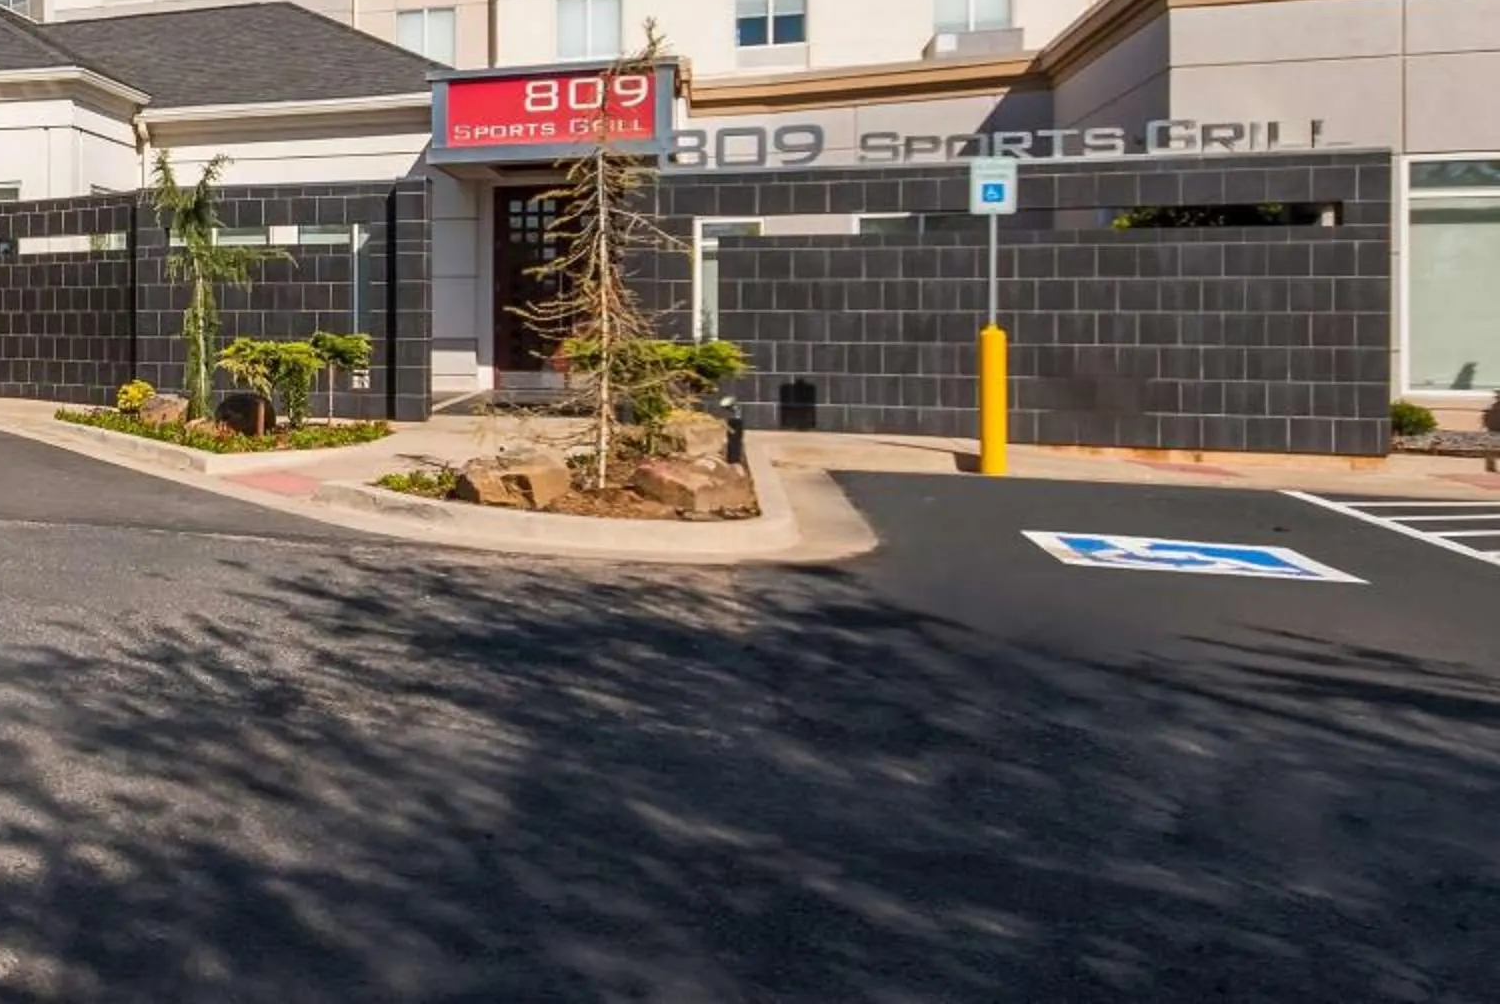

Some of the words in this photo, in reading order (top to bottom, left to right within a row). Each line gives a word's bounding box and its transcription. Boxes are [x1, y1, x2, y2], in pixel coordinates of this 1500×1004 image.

[524, 75, 648, 111] 809
[454, 123, 555, 140] SPORTS
[672, 124, 824, 167] 809
[858, 127, 1125, 163] SPORTS
